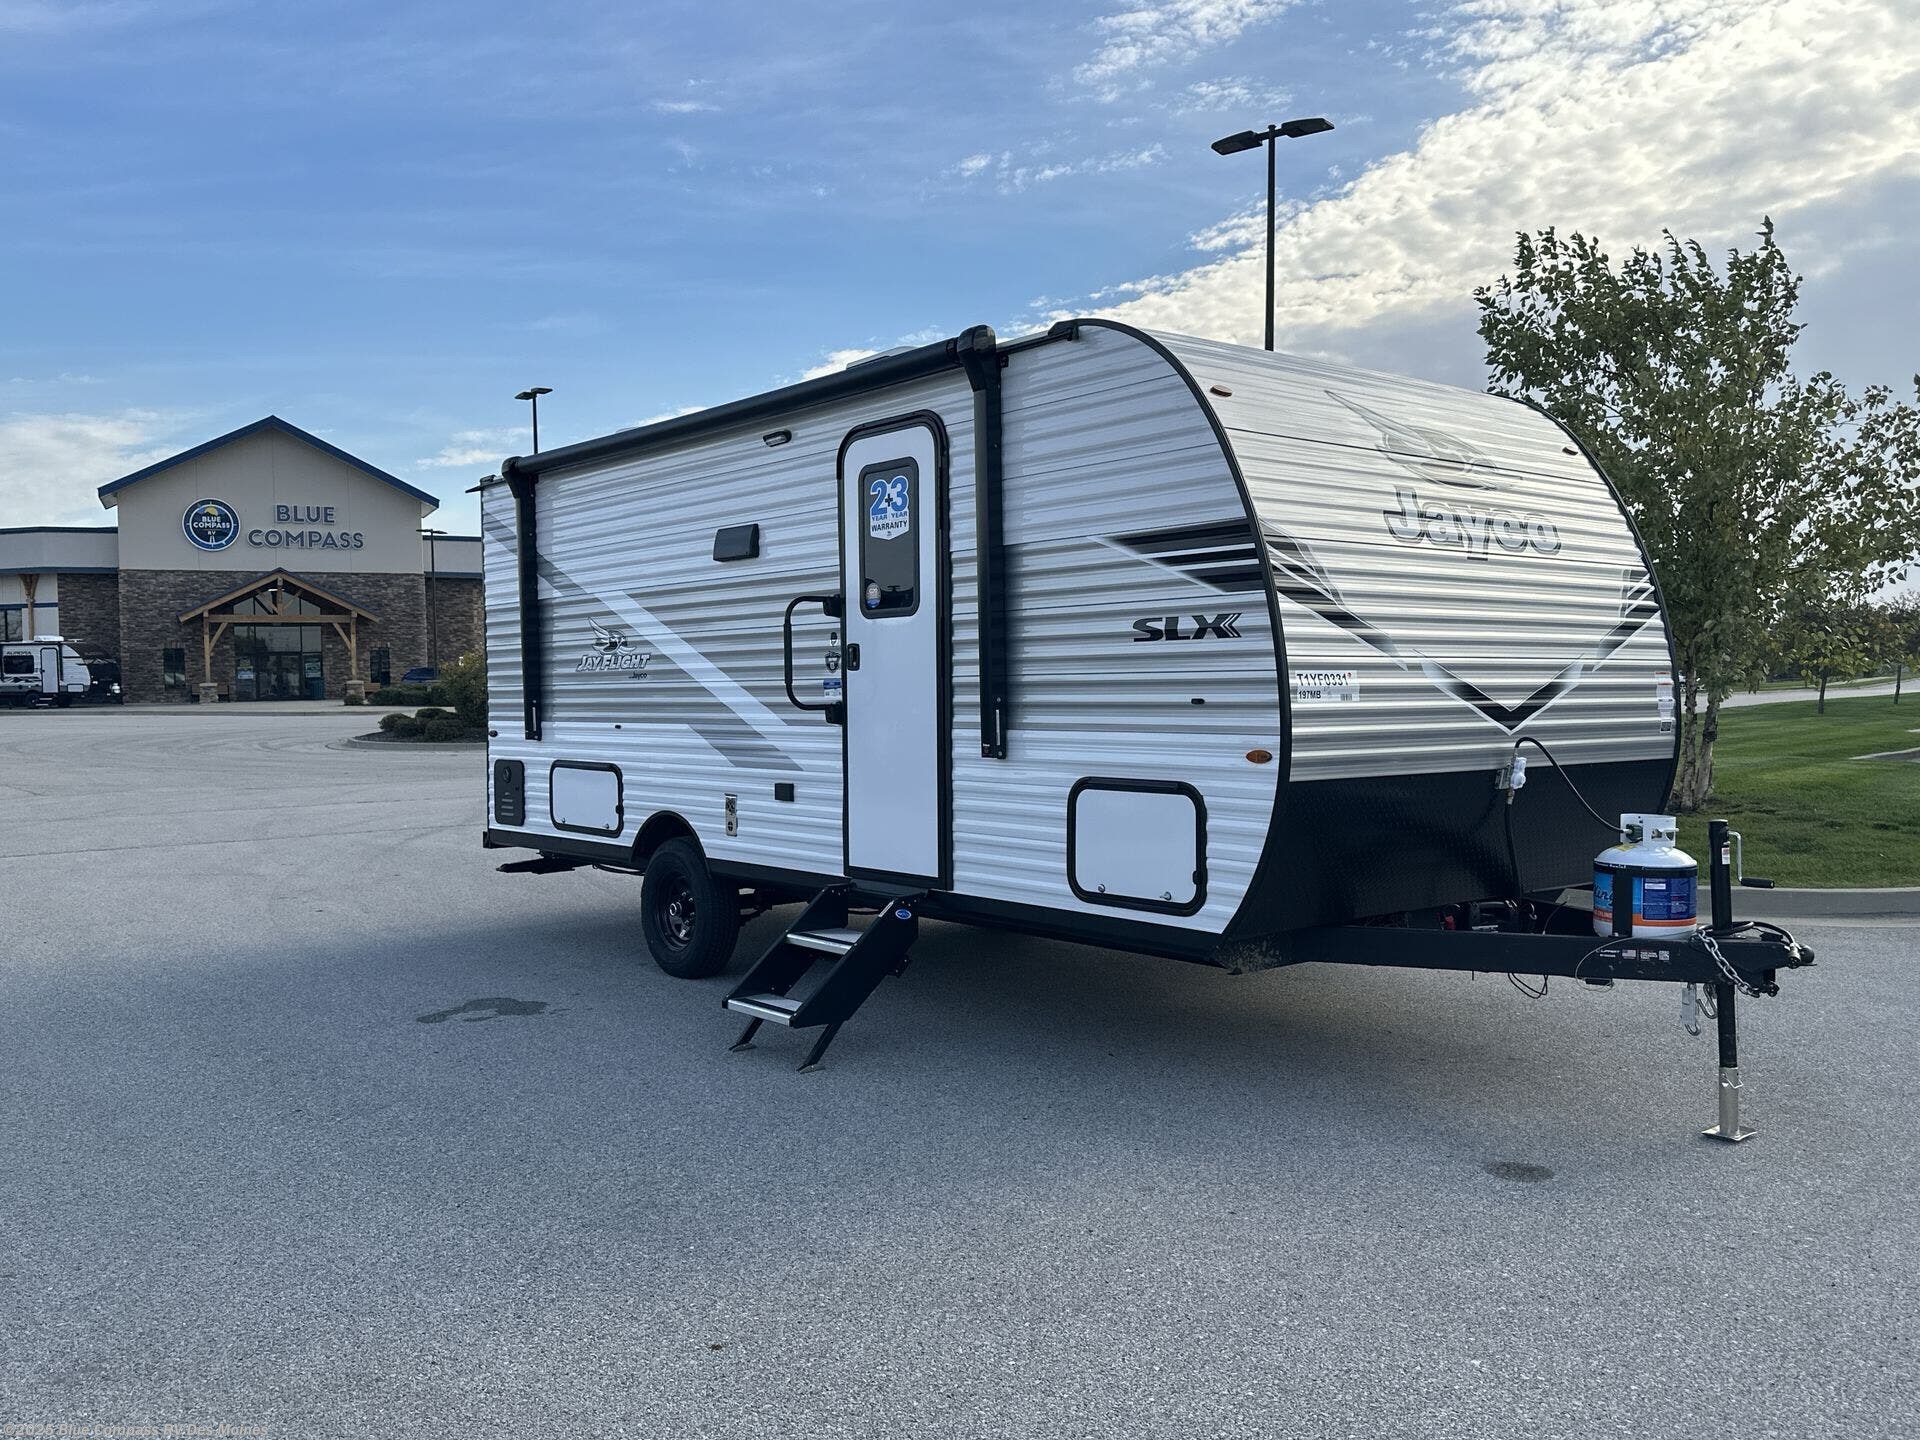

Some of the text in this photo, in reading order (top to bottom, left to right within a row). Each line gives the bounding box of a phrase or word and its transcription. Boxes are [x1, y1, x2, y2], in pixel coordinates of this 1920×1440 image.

[276, 504, 335, 524] BLUE
[891, 511, 908, 519] YEAR
[1383, 485, 1562, 561] Jayco
[871, 520, 908, 532] WARRANTY
[248, 529, 364, 549] COMPASS
[1132, 612, 1242, 642] SLX
[600, 653, 651, 671] FLIGHT
